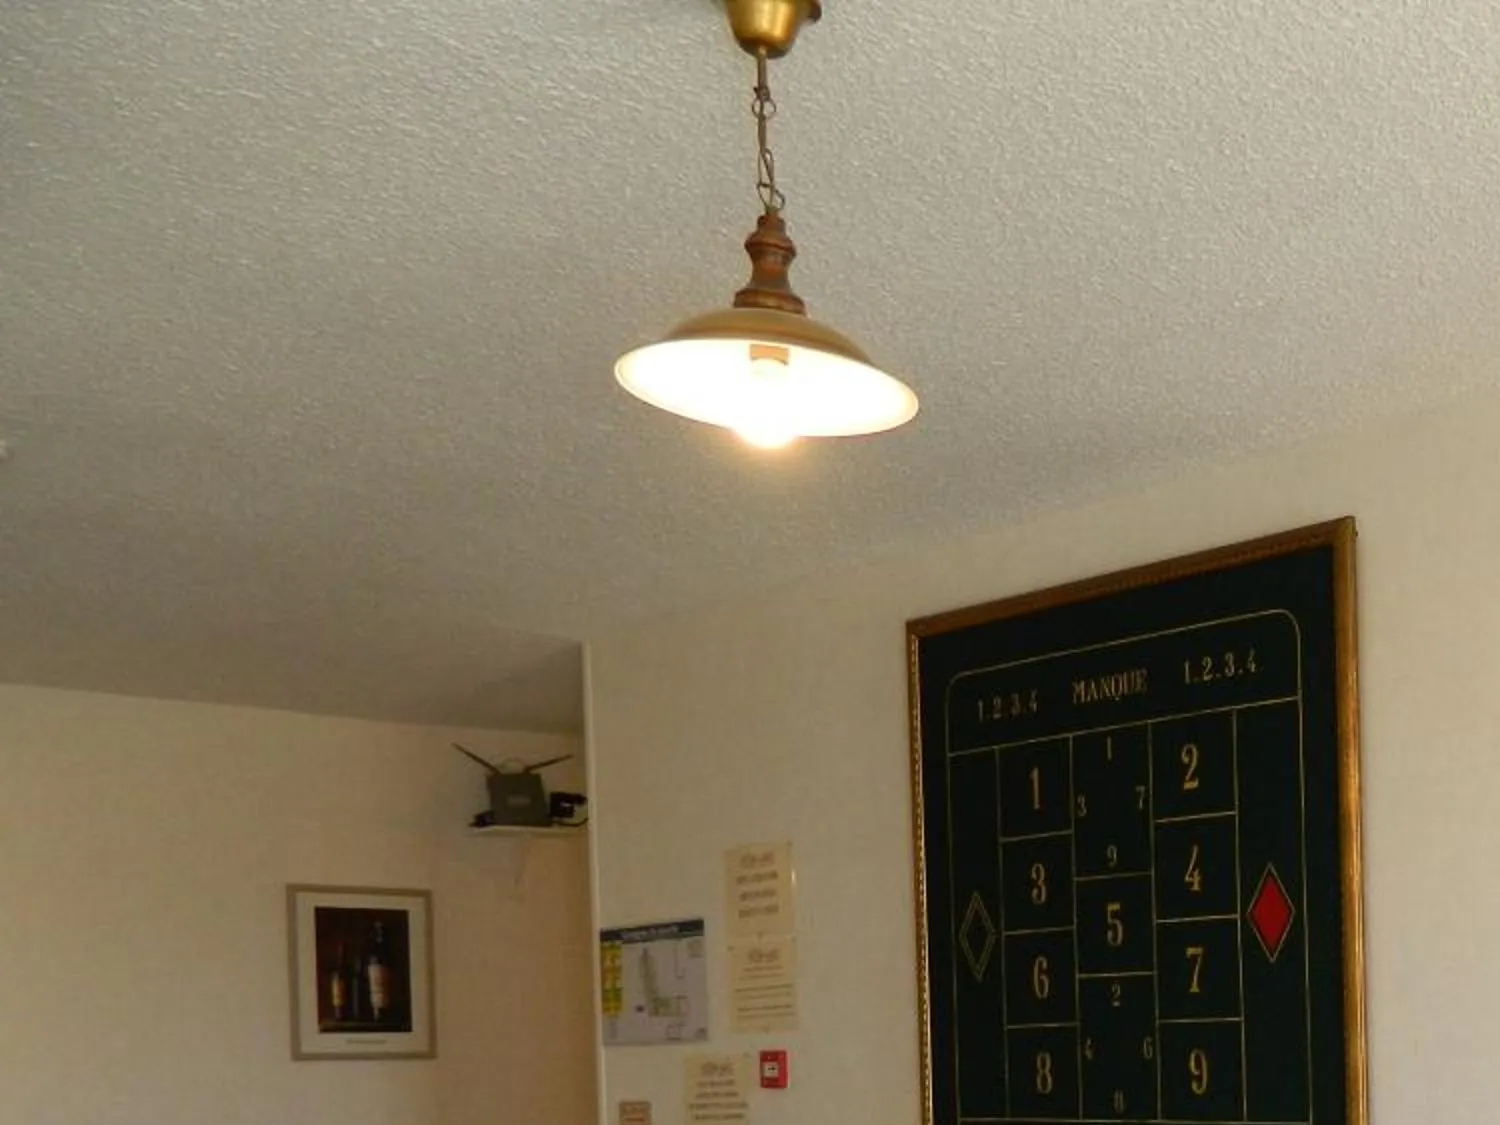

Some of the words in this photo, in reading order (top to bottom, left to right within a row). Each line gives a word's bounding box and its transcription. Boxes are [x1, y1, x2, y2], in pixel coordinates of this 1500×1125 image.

[1071, 668, 1149, 704] MANQUE
[1029, 766, 1042, 810] 1
[1181, 743, 1200, 790] 2
[1031, 862, 1047, 905] 3
[1184, 845, 1202, 891] 4
[1107, 903, 1123, 946] 5
[1033, 956, 1050, 999] 6
[1186, 947, 1204, 993] 7
[1036, 1052, 1053, 1095] 8
[1188, 1048, 1208, 1095] 9
